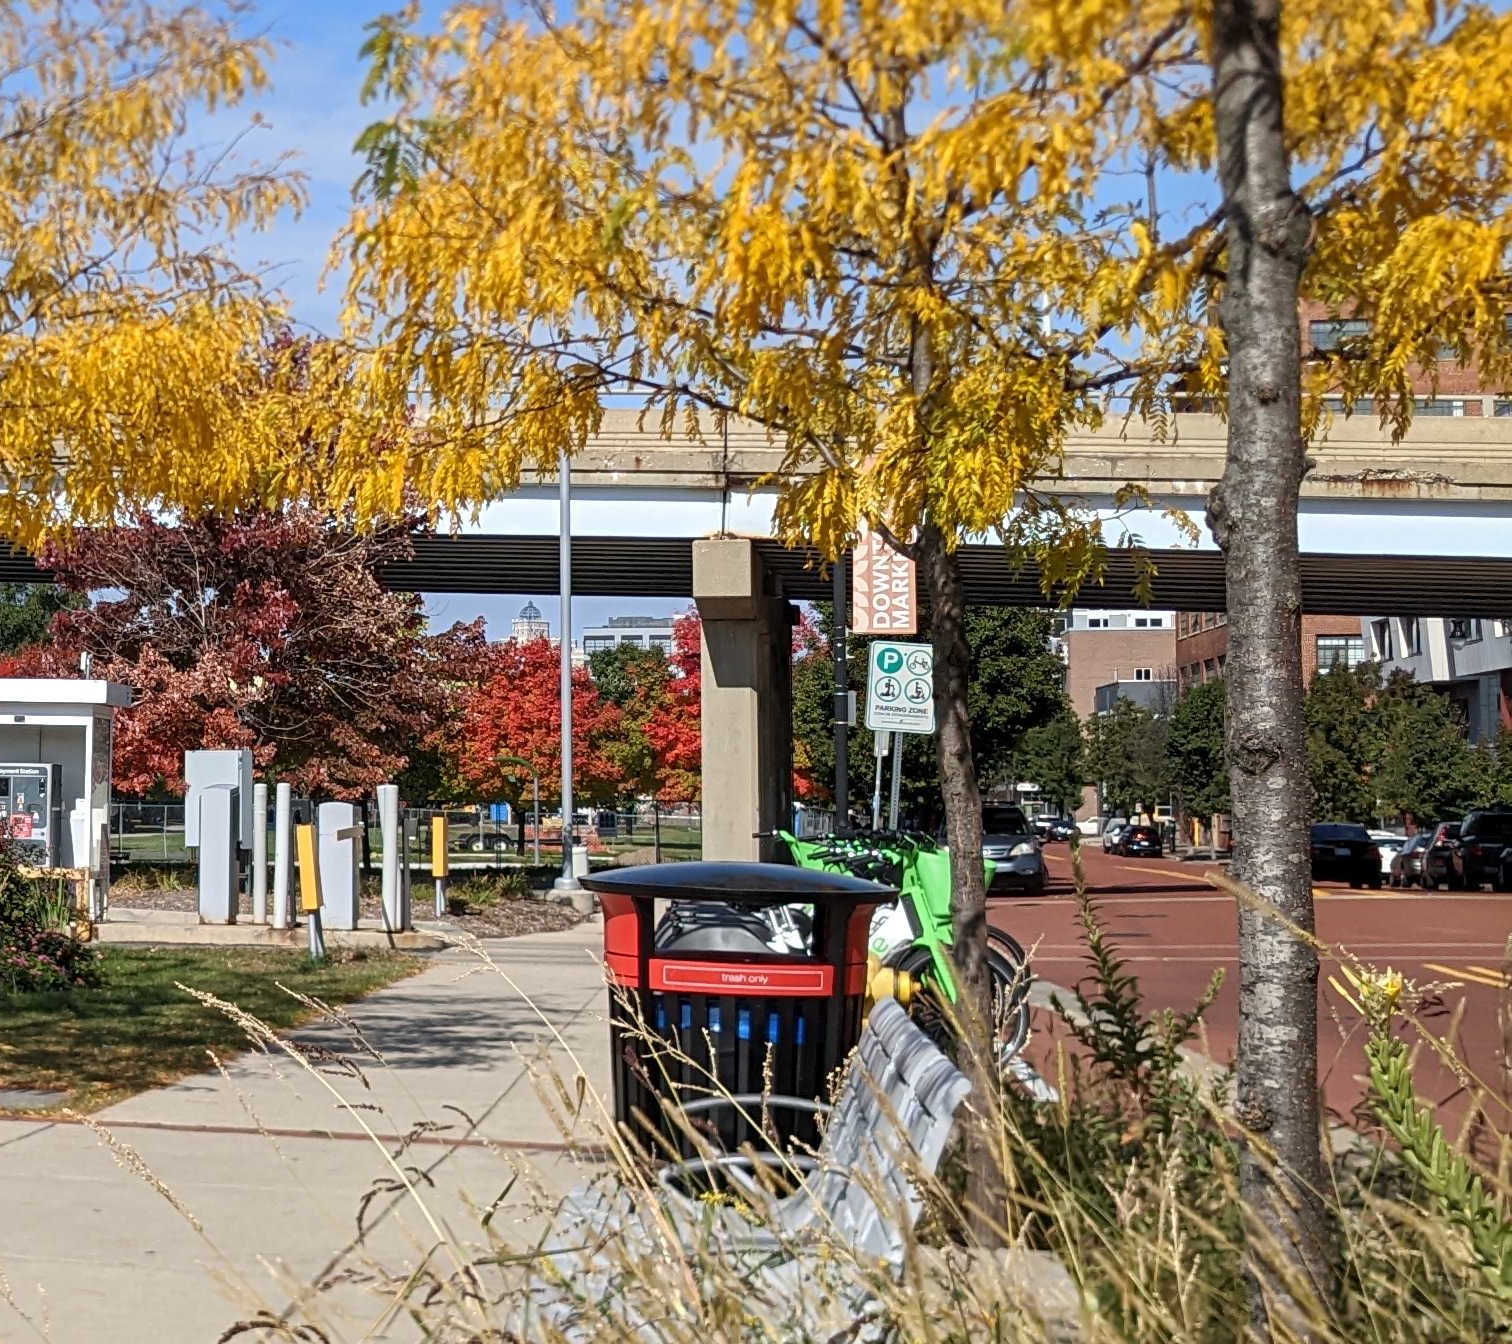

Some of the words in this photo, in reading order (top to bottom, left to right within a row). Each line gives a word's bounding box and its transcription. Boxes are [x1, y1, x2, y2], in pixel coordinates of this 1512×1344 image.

[884, 652, 898, 669] P
[875, 705, 907, 713] PARKING
[721, 973, 746, 983] trash
[748, 974, 768, 985] only
